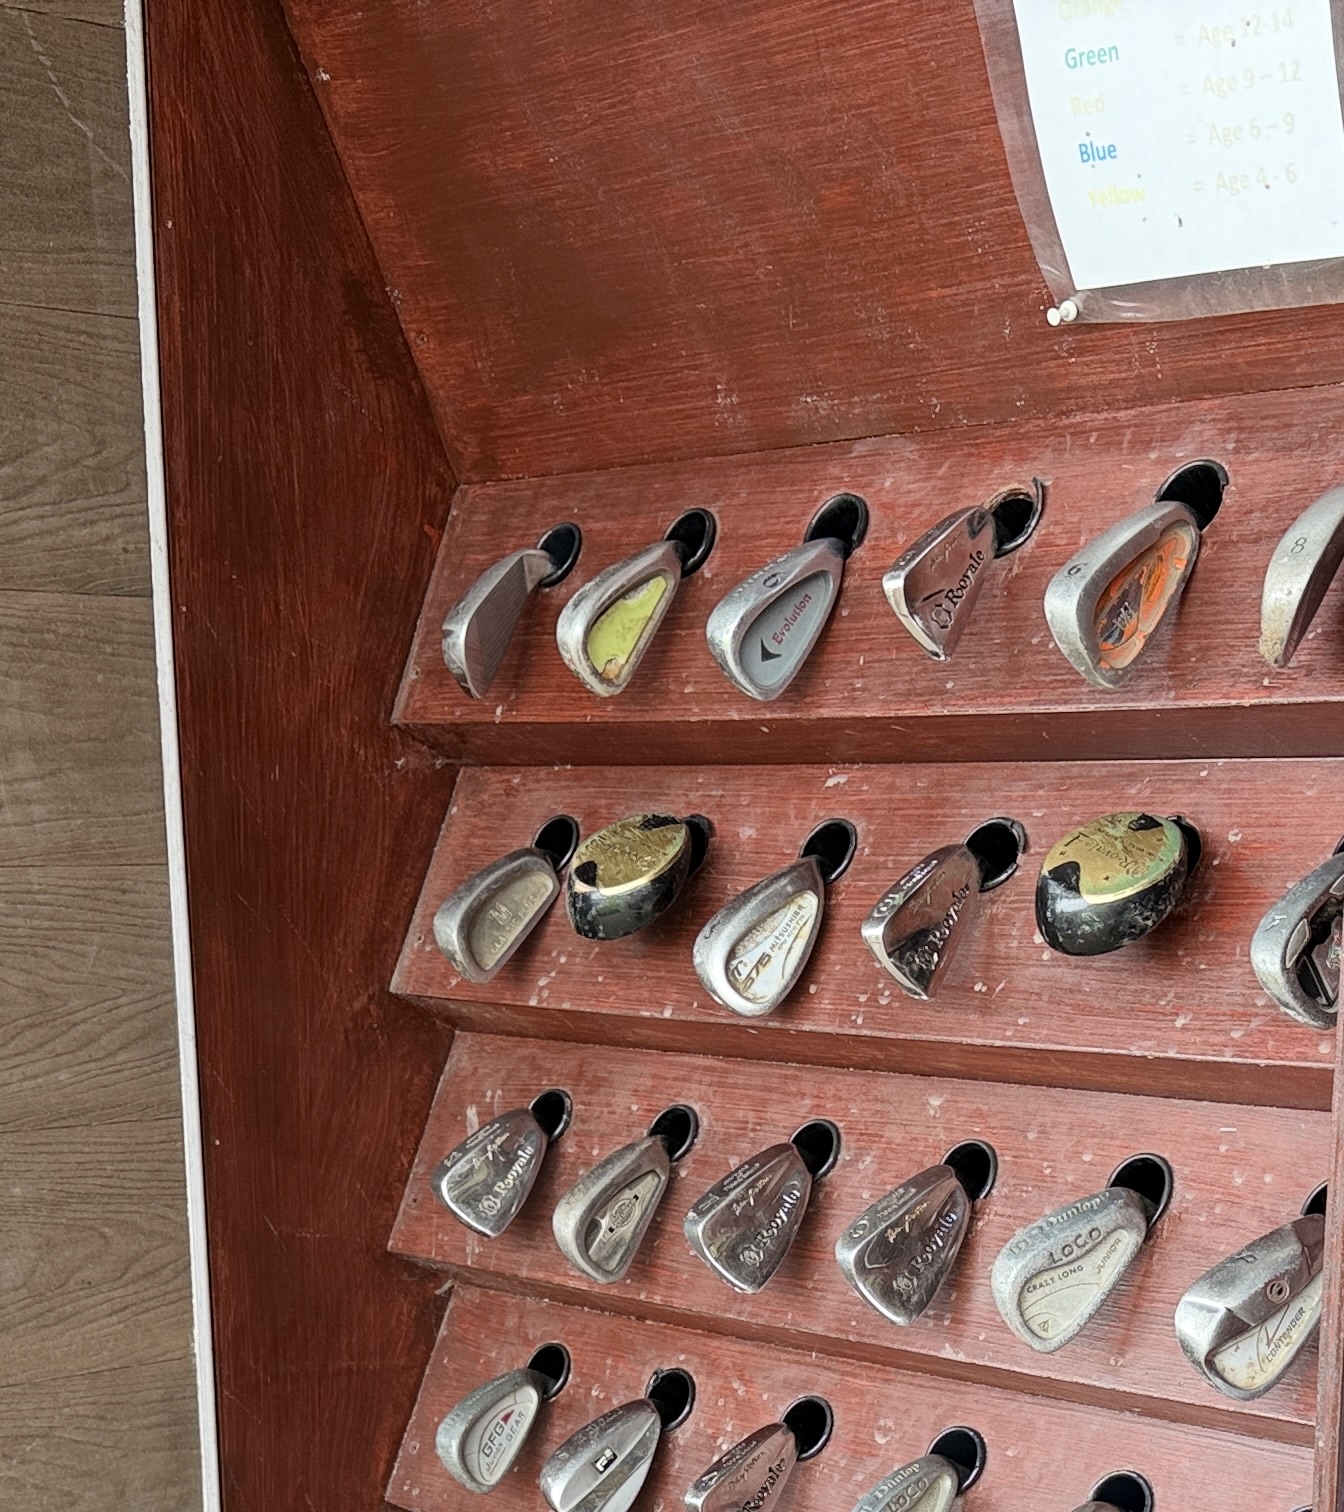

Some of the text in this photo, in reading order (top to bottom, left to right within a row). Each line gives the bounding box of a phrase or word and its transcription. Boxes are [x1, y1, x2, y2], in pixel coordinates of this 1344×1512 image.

[1064, 43, 1120, 70] Green
[1197, 24, 1233, 49] Age
[1071, 92, 1105, 118] Red
[1202, 75, 1238, 99] Age
[1278, 60, 1302, 84] 12
[1079, 141, 1118, 164] Blue
[1208, 124, 1244, 149] Age
[1087, 184, 1145, 211] Yellow
[1216, 171, 1250, 197] Age
[1291, 538, 1307, 554] 8
[945, 549, 986, 609] Royale
[771, 593, 812, 645] Evolution
[493, 1145, 535, 1197] Royale
[1048, 1226, 1103, 1267] LOCO
[1095, 1237, 1123, 1275] JUNIOR
[1025, 1263, 1085, 1294] CRAZY LONG
[1265, 1305, 1307, 1364] CONTENDER
[481, 1420, 506, 1459] GFG
[505, 1410, 526, 1443] GEAR
[872, 1463, 921, 1500] Dunlop
